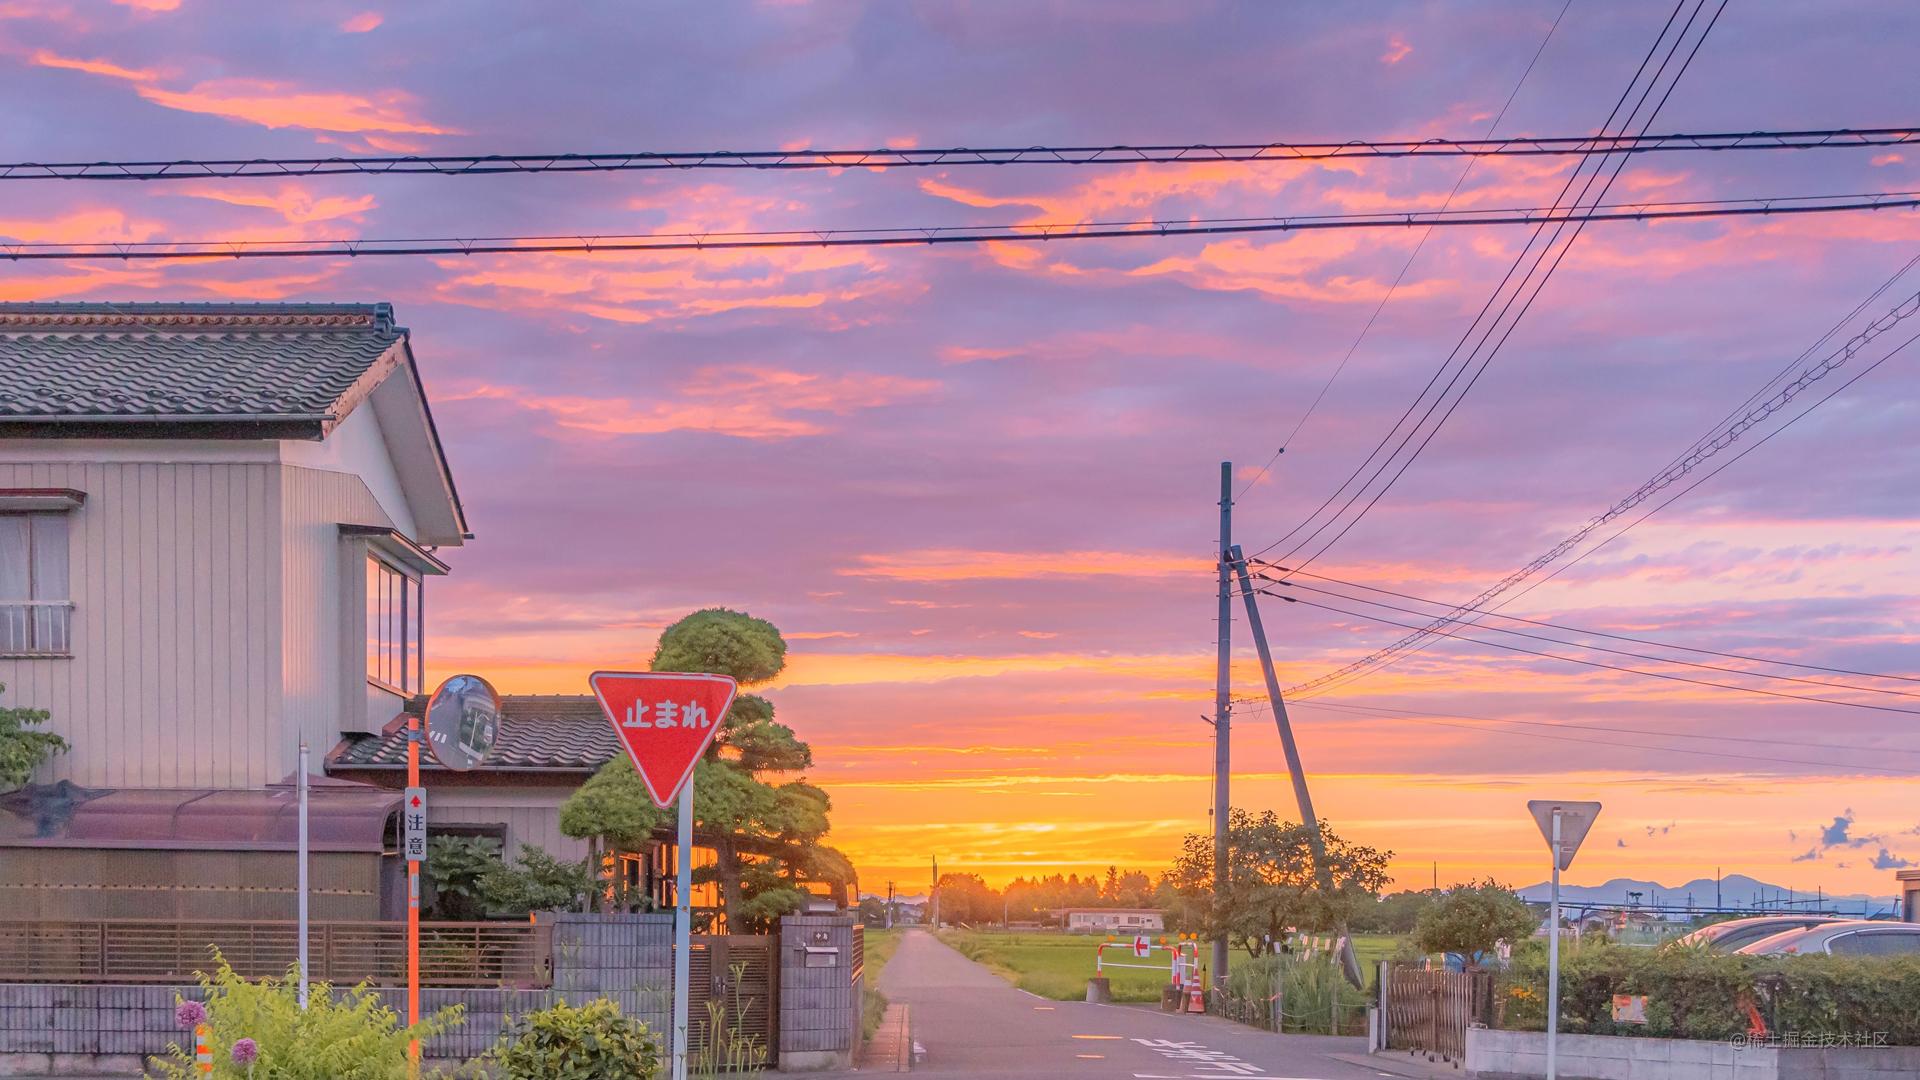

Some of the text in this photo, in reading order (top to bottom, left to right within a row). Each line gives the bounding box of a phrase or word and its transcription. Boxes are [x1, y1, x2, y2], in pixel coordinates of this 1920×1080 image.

[622, 698, 711, 729] 止まれ
[408, 814, 424, 855] 注意
